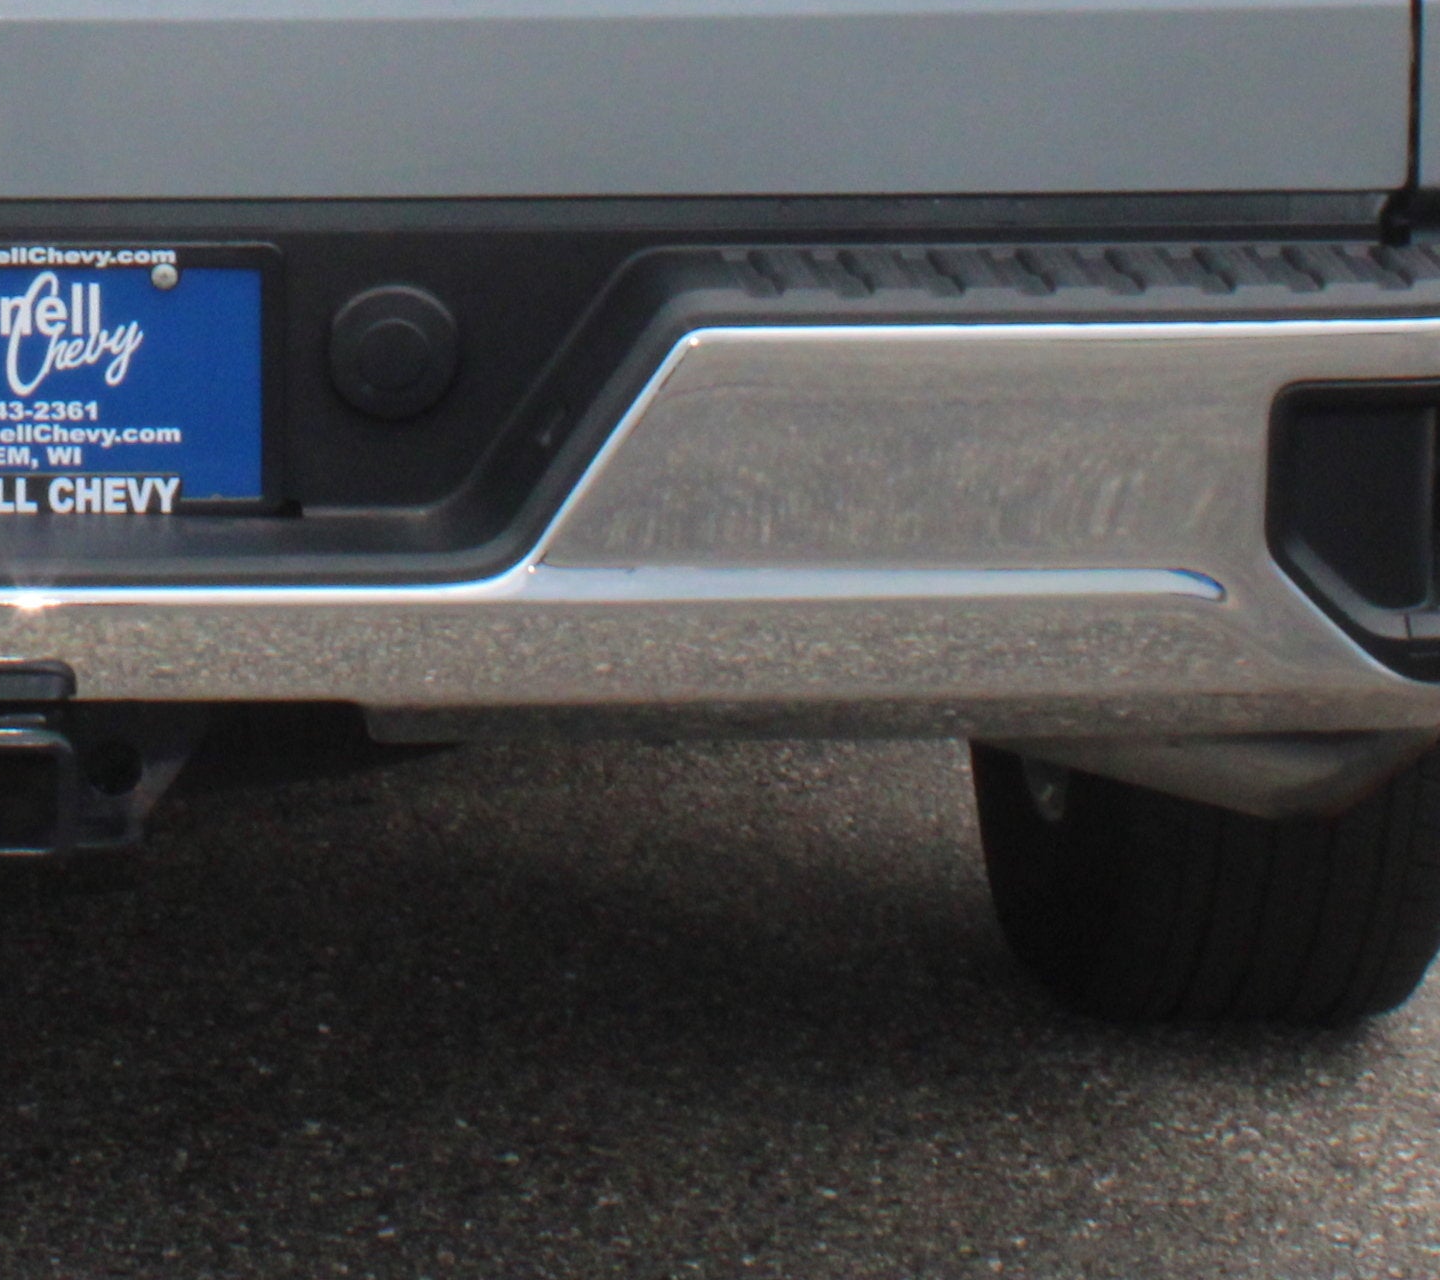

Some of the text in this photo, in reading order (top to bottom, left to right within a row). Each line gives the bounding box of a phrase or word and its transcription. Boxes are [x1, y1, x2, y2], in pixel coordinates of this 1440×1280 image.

[6, 270, 144, 396] Chevy
[46, 446, 82, 466] WI
[48, 477, 180, 514] CHEVY
